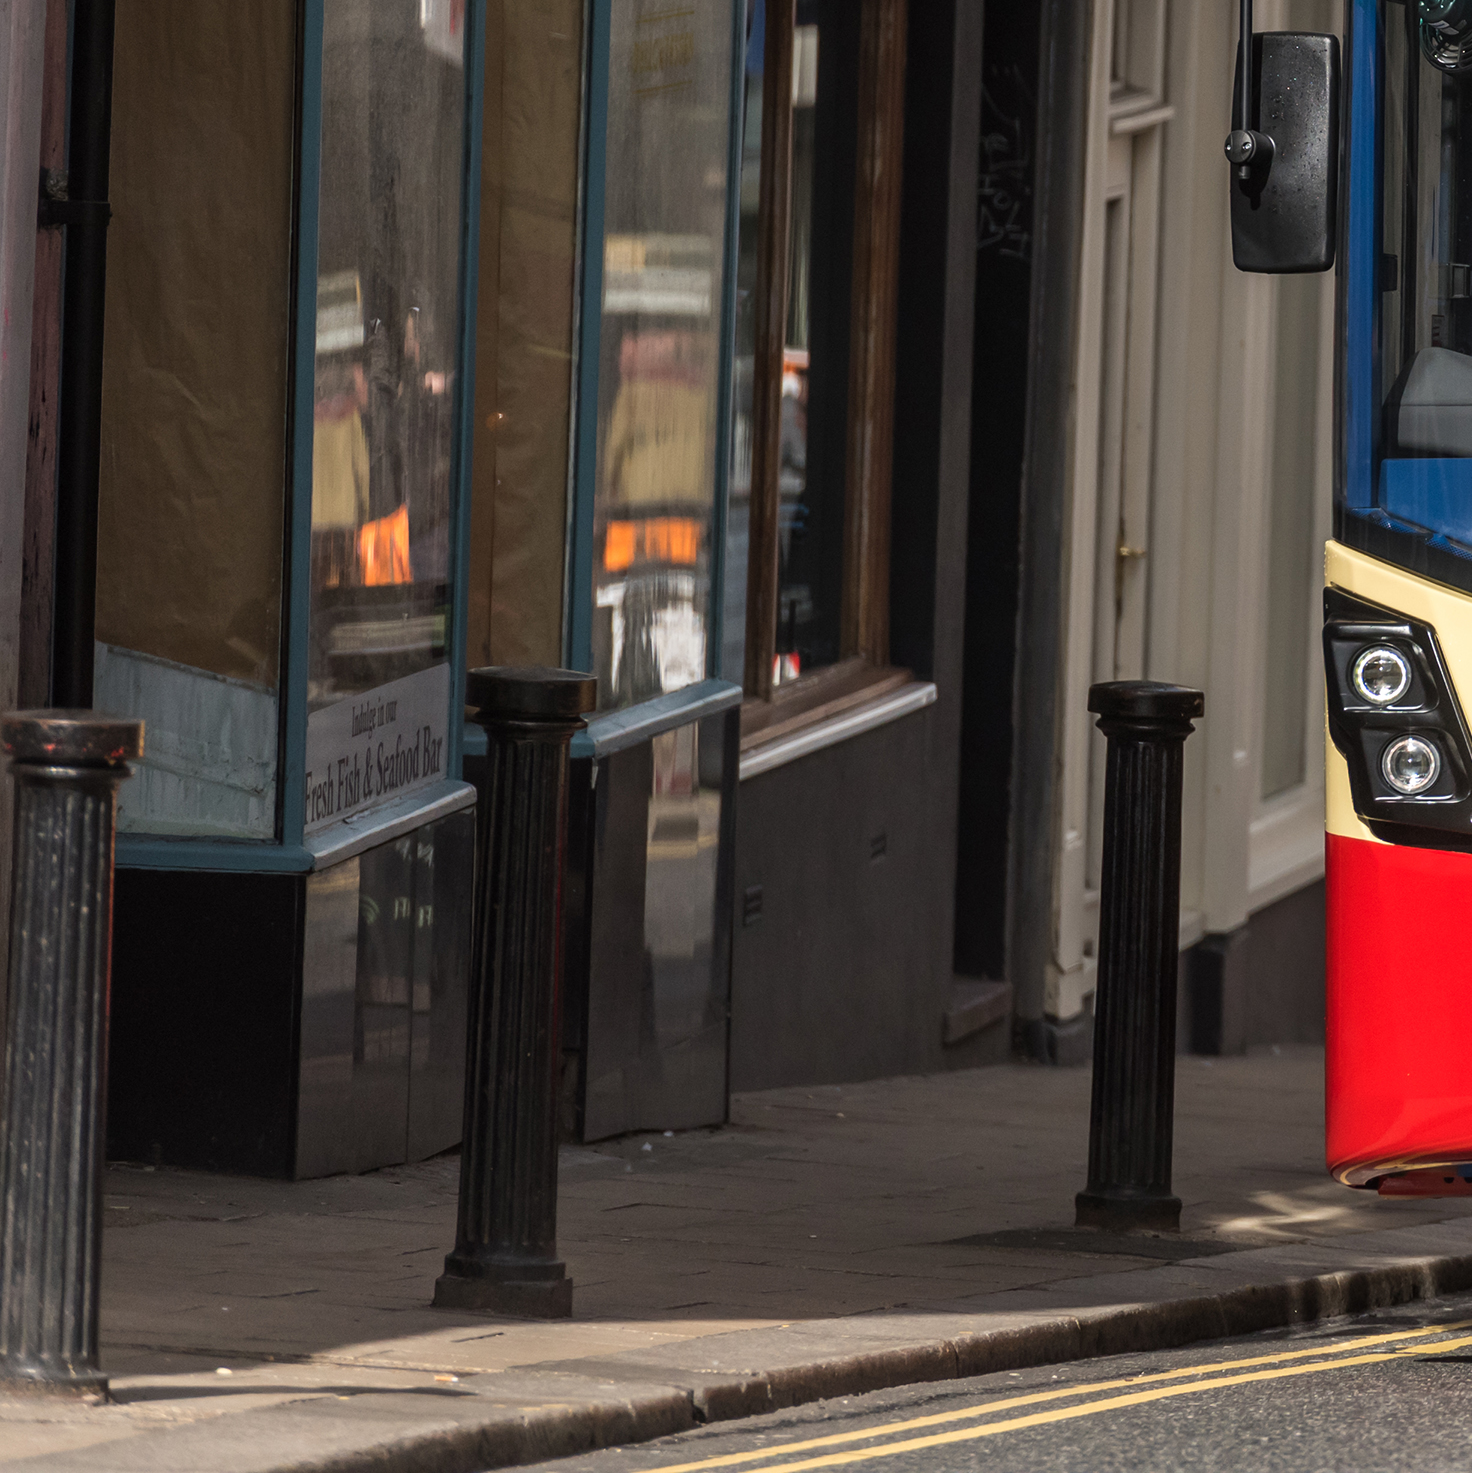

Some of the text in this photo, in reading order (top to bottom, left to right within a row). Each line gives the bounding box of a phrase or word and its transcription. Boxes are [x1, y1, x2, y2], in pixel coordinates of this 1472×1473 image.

[352, 696, 398, 739] Indulge in our
[305, 725, 442, 824] Fresh Fish & Seafood Bar
